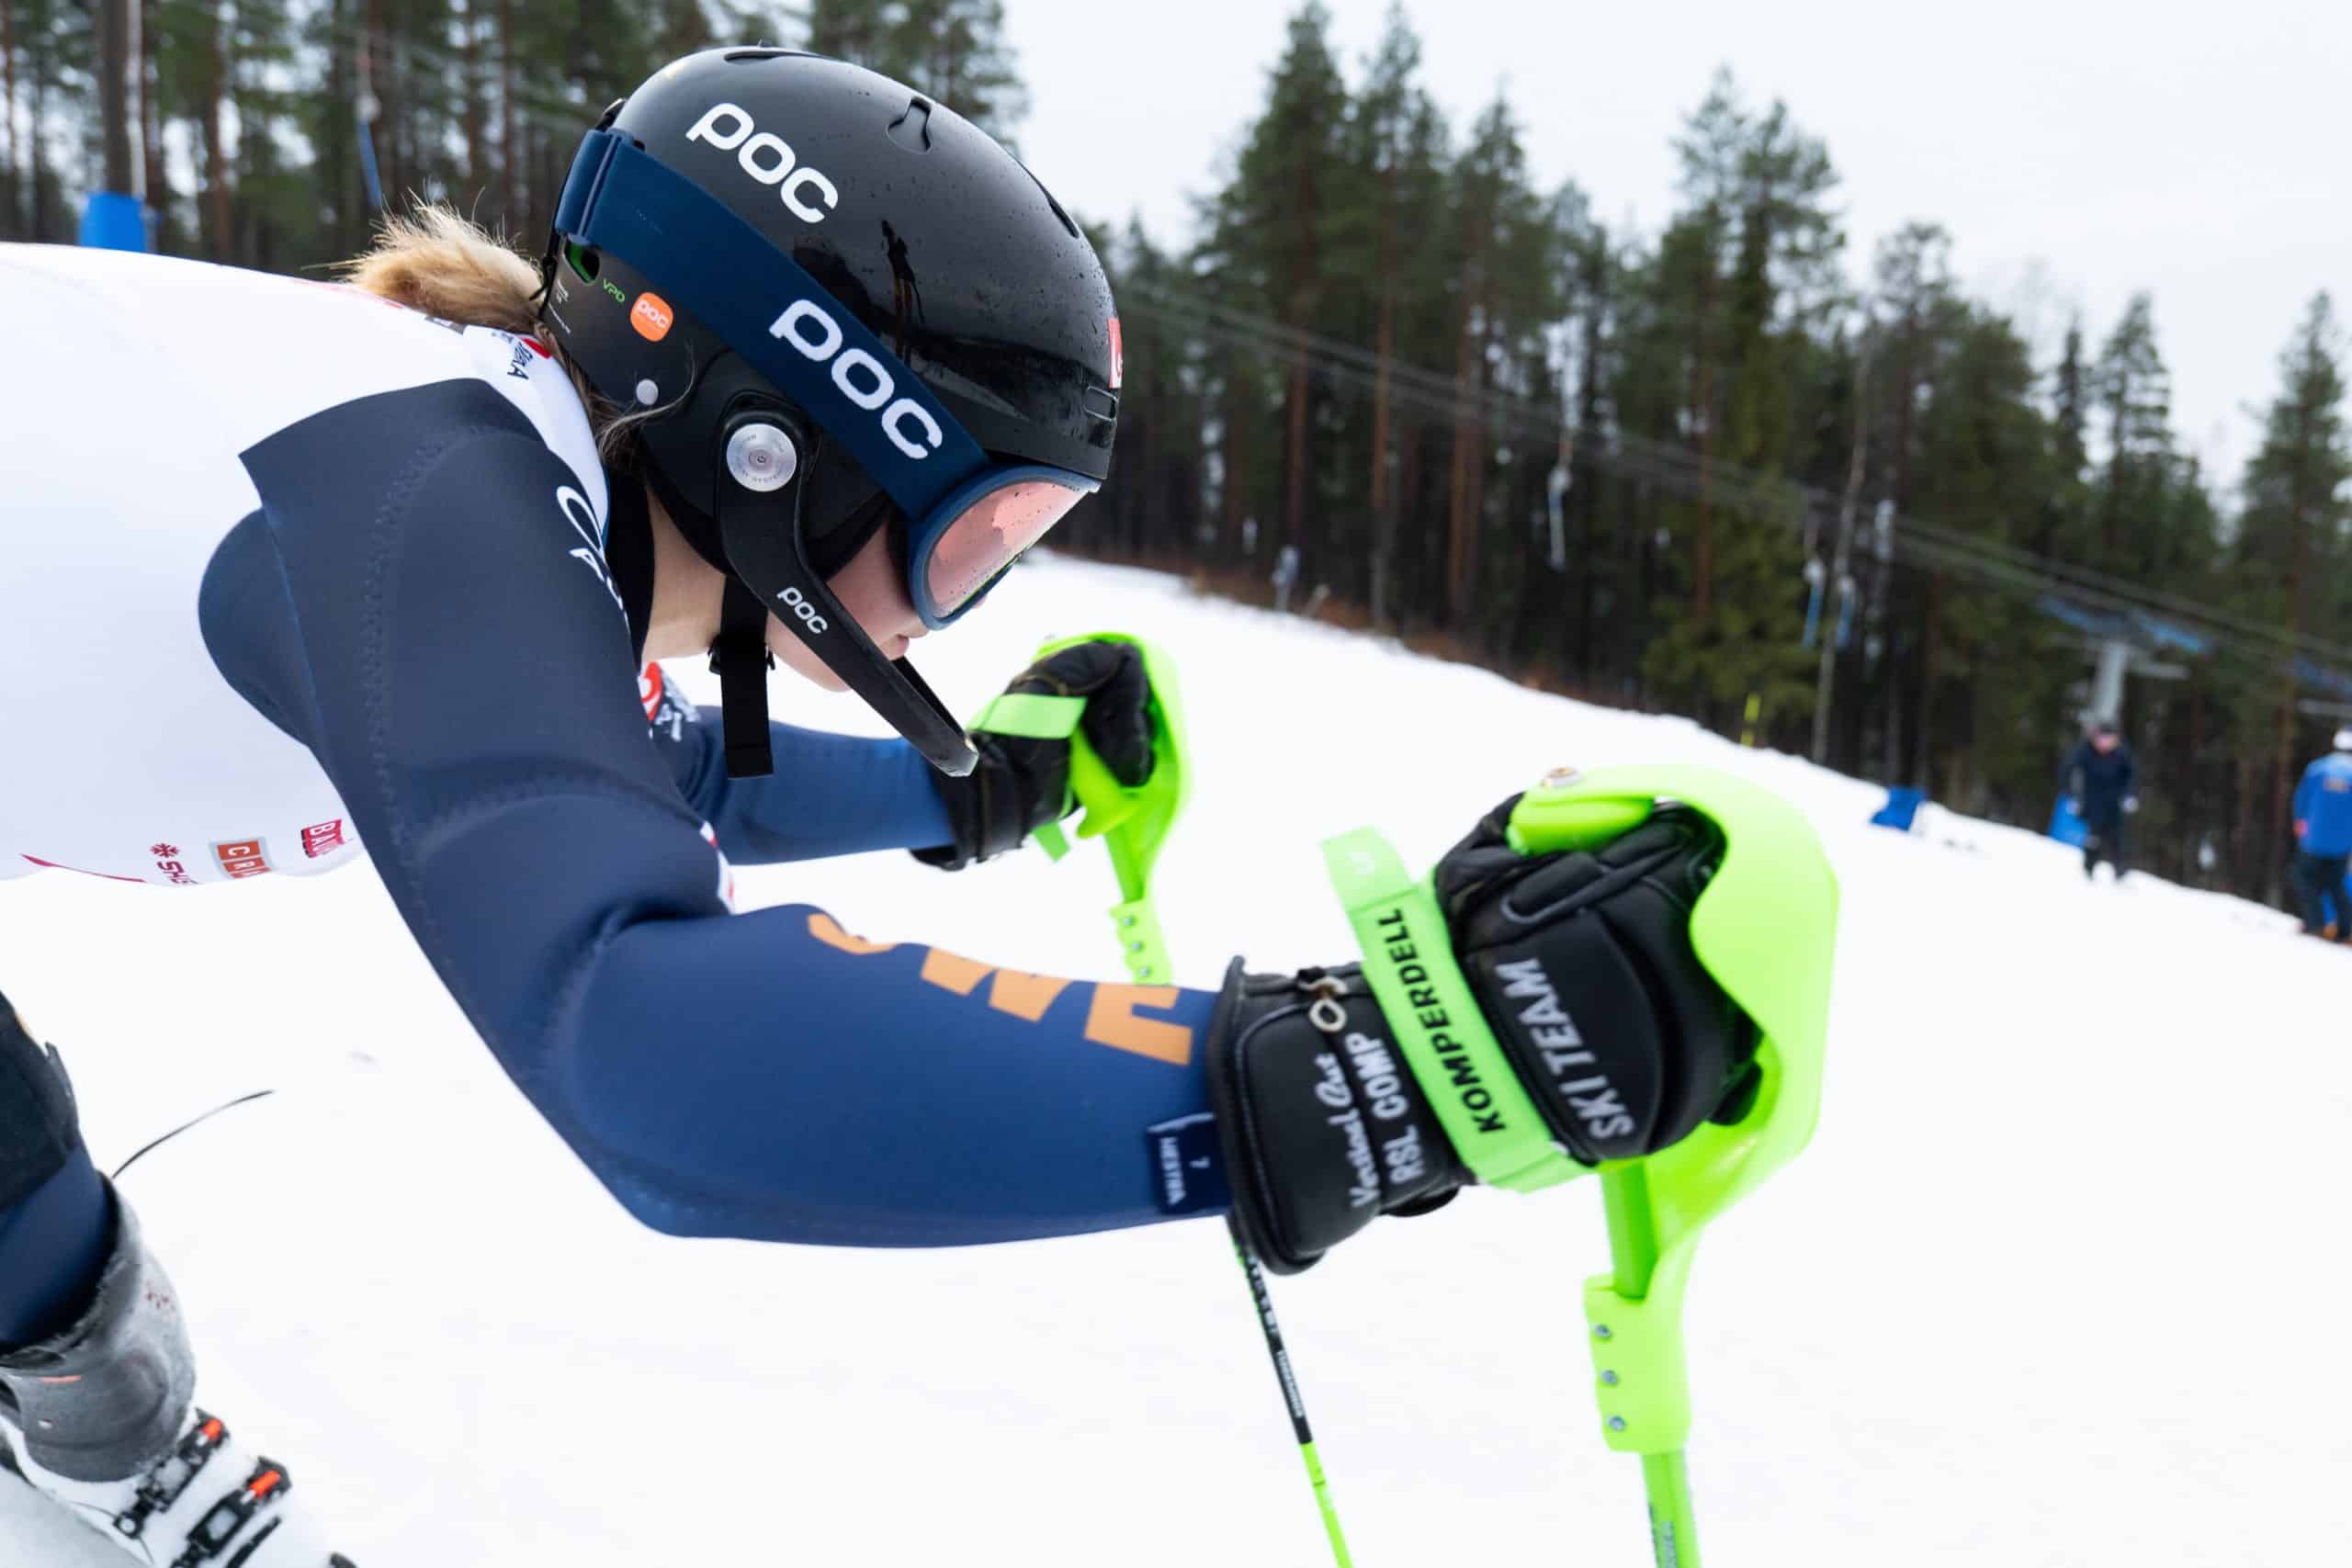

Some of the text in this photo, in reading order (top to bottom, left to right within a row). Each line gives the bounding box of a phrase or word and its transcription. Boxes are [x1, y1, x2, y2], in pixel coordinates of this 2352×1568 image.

[1344, 1032, 1425, 1185] RSL COMP
[1376, 908, 1508, 1134] KOMPERDELL
[1496, 957, 1634, 1139] SKI TEAM
